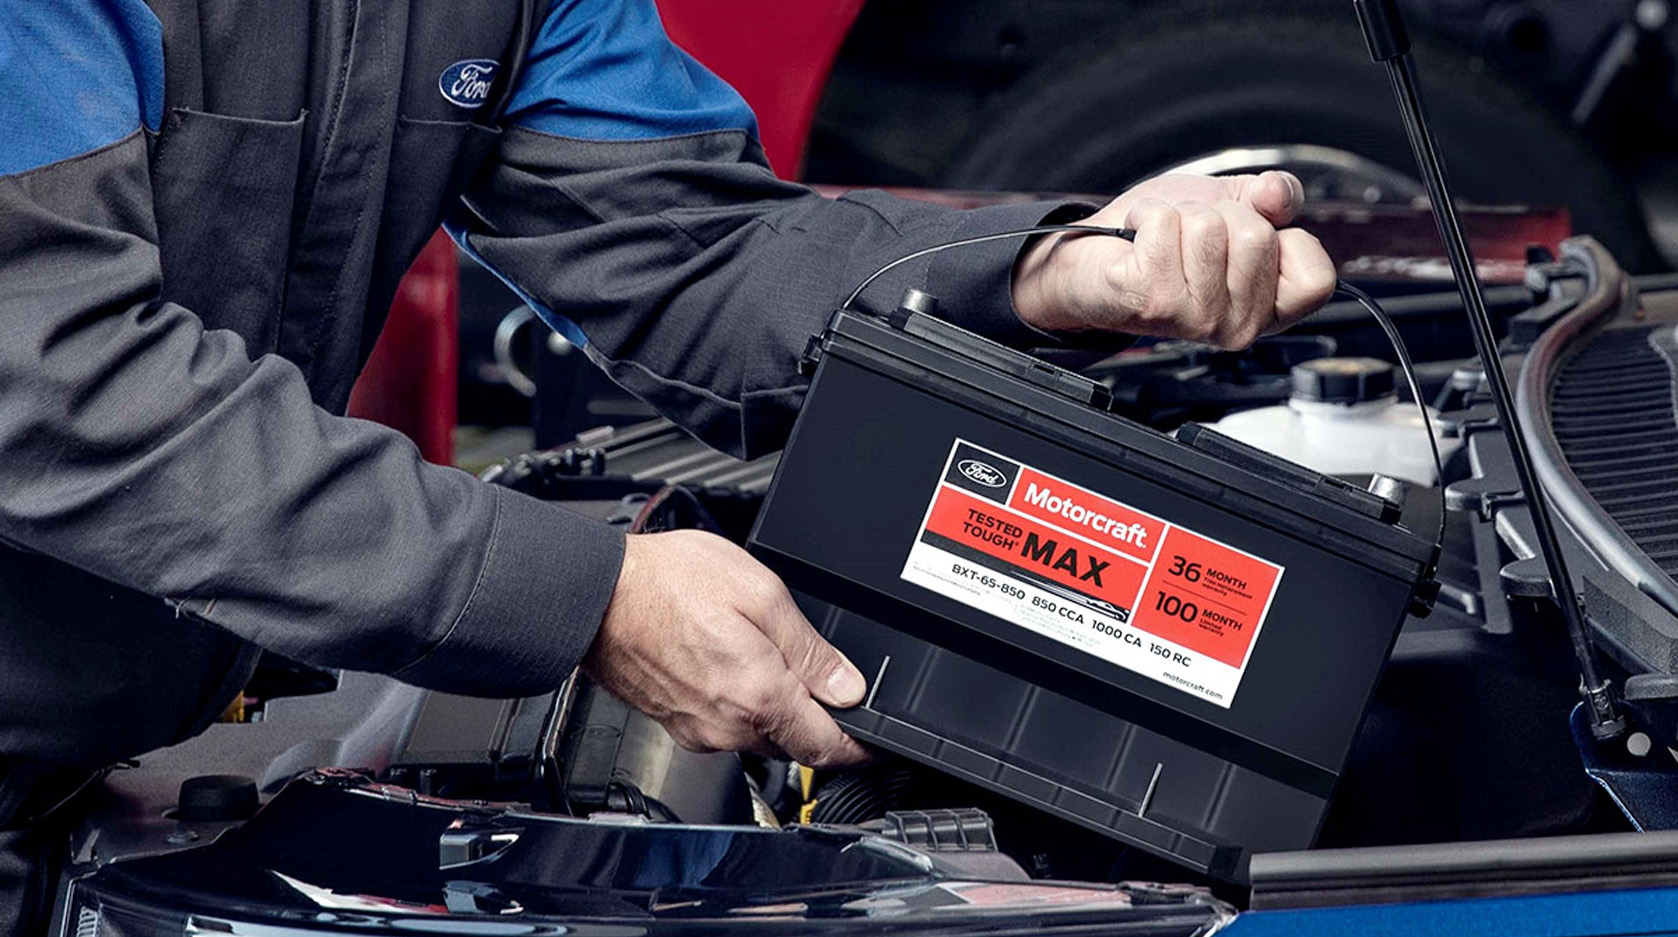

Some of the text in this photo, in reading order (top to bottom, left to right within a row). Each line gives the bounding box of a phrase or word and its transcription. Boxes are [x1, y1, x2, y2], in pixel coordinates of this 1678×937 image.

[965, 463, 999, 484] Ford
[968, 508, 1023, 538] TESTED
[1024, 482, 1147, 549] Motorcraft
[1021, 532, 1111, 588] MAX
[1168, 555, 1202, 583] 36
[1206, 568, 1247, 590] MONTH
[952, 563, 1026, 600] BXT-65-850
[1031, 596, 1057, 613] 850
[1058, 606, 1085, 625] CCA
[1091, 619, 1123, 640] 1000
[1124, 633, 1143, 649] CA
[1150, 642, 1172, 660] 150
[1172, 652, 1192, 668] RC
[1156, 591, 1198, 623] 100
[1202, 609, 1242, 631] MONTH
[1162, 671, 1224, 701] motorcraft.com
